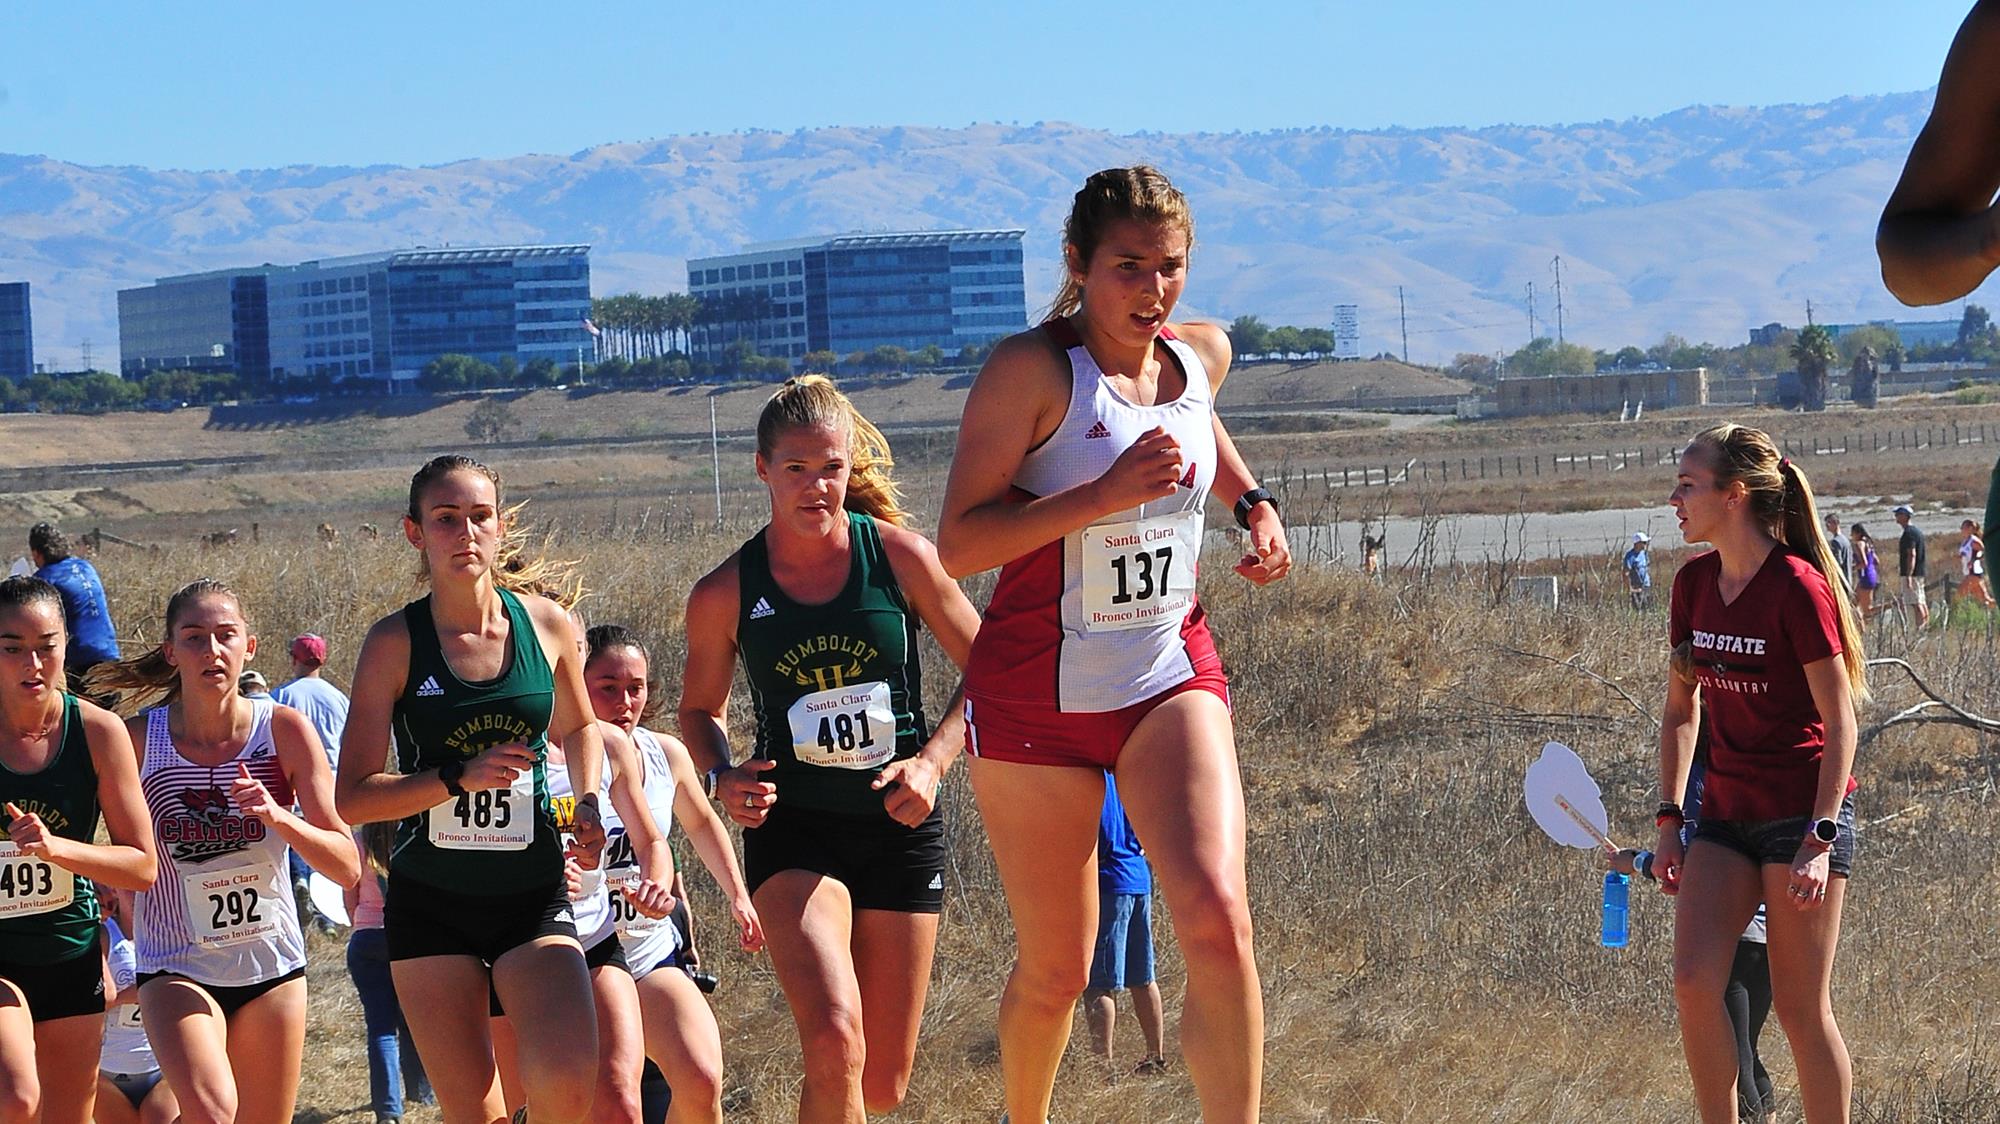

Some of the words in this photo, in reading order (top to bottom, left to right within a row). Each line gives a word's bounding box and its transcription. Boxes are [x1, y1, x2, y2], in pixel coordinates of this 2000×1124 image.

[1085, 431, 1111, 439] adidas
[1104, 533, 1141, 549] Santa
[1144, 527, 1175, 542] Clara
[1111, 546, 1173, 605] 137
[750, 608, 775, 619] adidas
[1093, 611, 1132, 623] Bronco
[1136, 596, 1187, 619] Invitational
[1716, 634, 1766, 655] STATE
[775, 634, 878, 677] HUMBOLDT
[810, 663, 845, 692] H
[1715, 678, 1768, 694] COUNTRY
[416, 688, 444, 697] adidas
[806, 700, 838, 713] Santa
[841, 693, 872, 706] Clara
[445, 713, 533, 748] HUMBOLDT
[817, 709, 874, 754] 481
[805, 755, 838, 764] Bronco
[841, 746, 891, 764] Invitational
[454, 789, 512, 829] 485
[158, 815, 266, 843] CHICO
[438, 832, 470, 842] Bronco
[473, 833, 526, 843] Invitational
[0, 850, 22, 858] anta
[172, 840, 250, 861] State
[0, 863, 53, 899] 493
[202, 879, 230, 890] Santa
[233, 874, 259, 885] Clara
[20, 895, 67, 909] Invitational
[208, 887, 262, 930] 292
[203, 934, 230, 943] Bronco
[232, 923, 275, 938] Invitational
